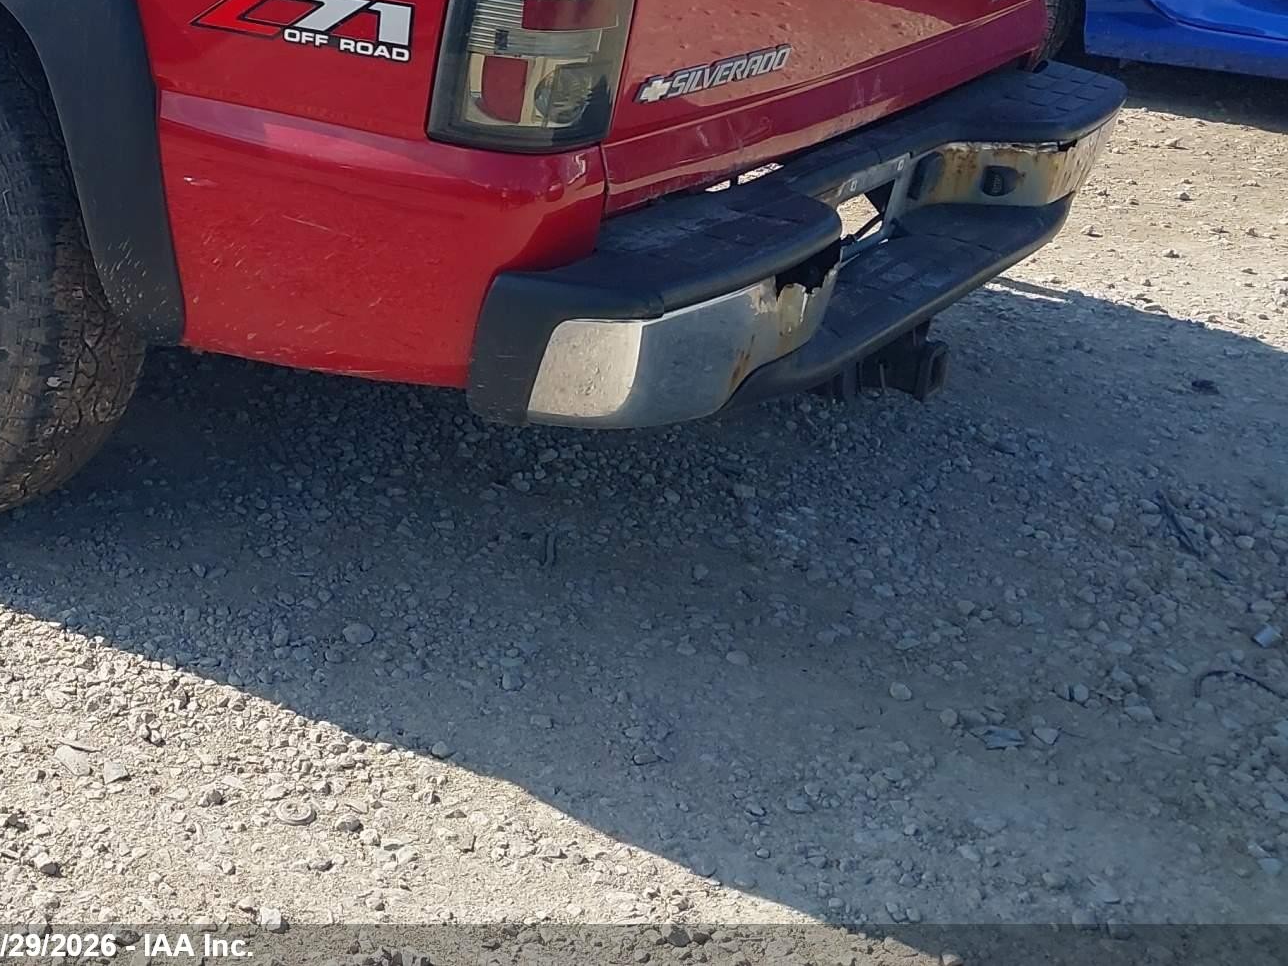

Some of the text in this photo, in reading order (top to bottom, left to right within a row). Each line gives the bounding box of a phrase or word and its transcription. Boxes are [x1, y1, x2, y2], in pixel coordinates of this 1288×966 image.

[283, 29, 411, 62] OFF ROAD
[666, 44, 793, 99] SILVERADO
